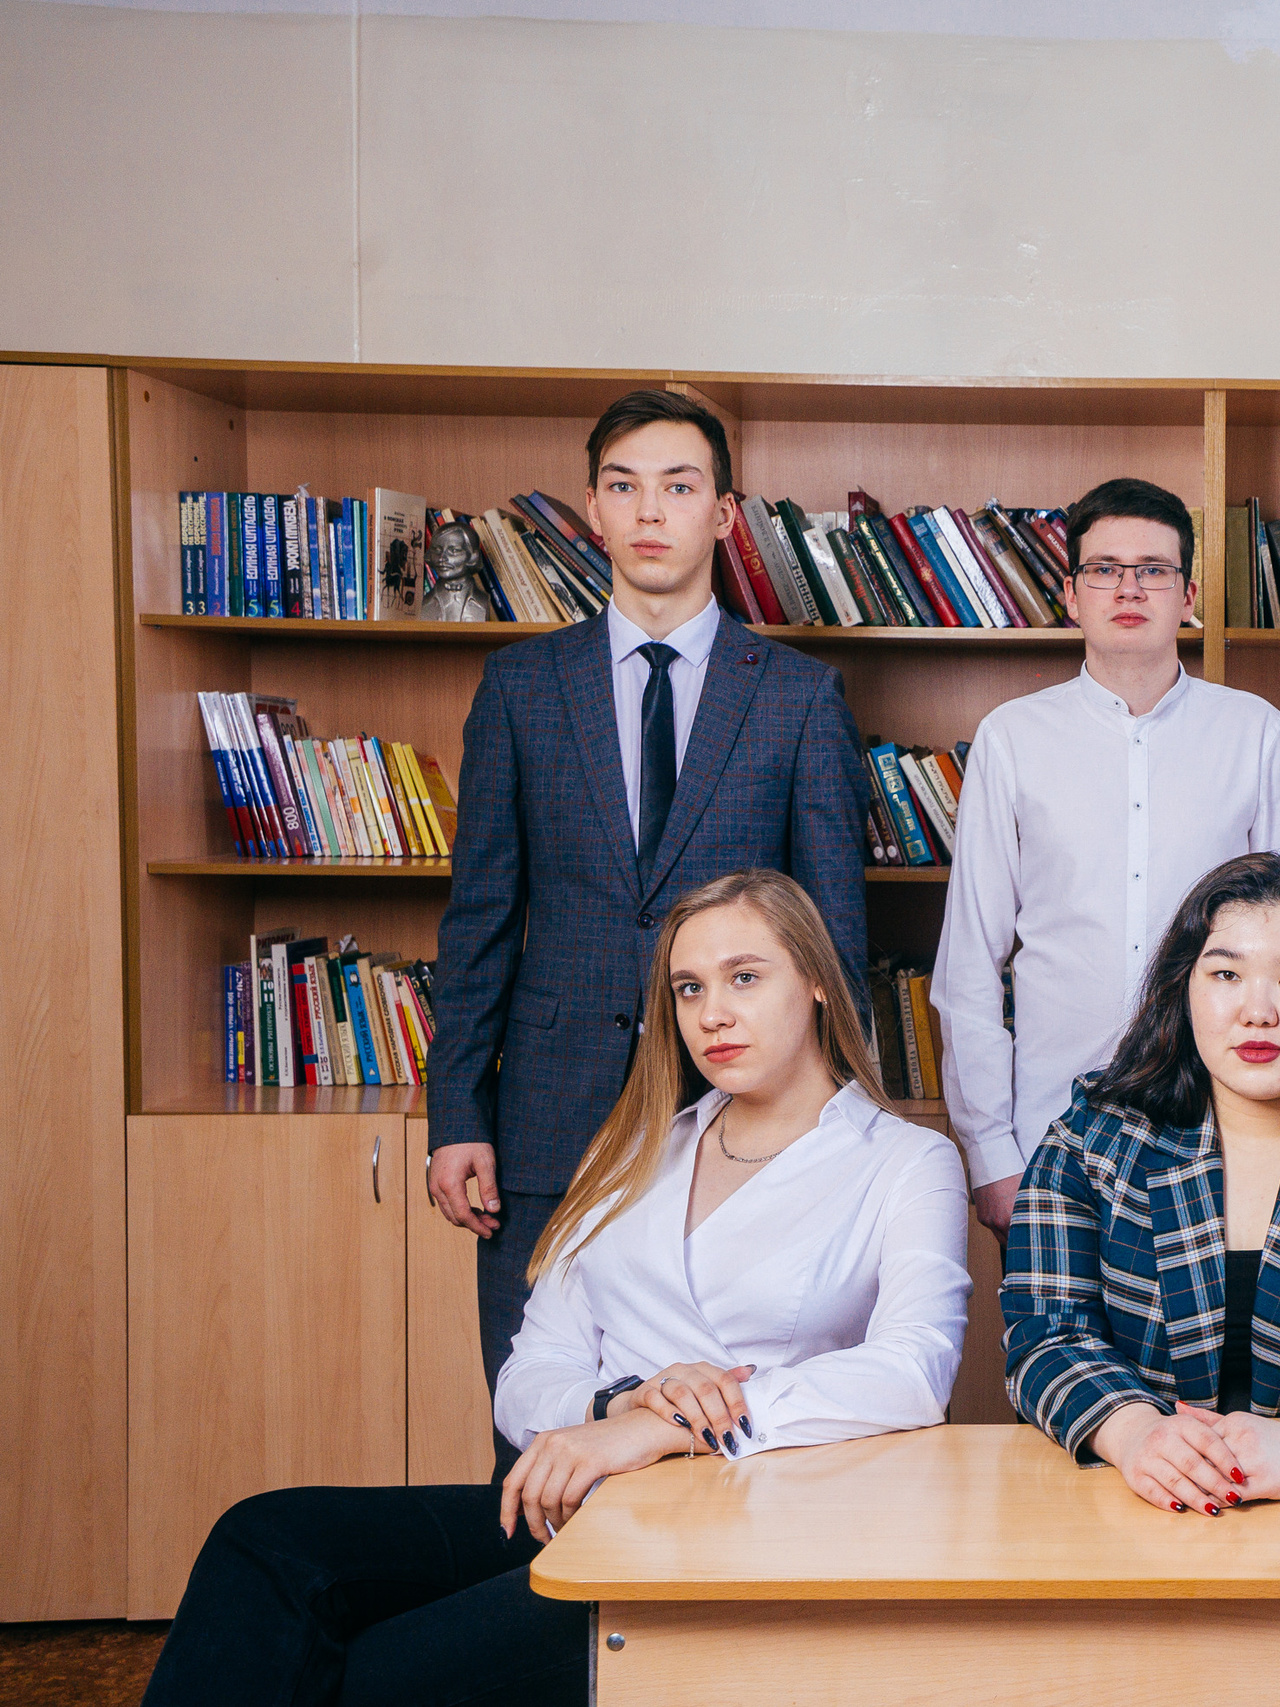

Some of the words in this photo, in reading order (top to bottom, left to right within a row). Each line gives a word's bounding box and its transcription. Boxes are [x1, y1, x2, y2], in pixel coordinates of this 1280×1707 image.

[243, 495, 257, 542] ЦИТАДЕЛЬ
[263, 495, 277, 543] ЦИТАДЕЛЬ
[283, 499, 298, 539] ЛИКБЕЗА
[244, 543, 258, 579] ЕДИНАЯ
[265, 544, 278, 580] ЕДИНАЯ
[285, 539, 300, 570] УРОКИ
[185, 600, 193, 614] 3
[198, 600, 205, 614] 3
[247, 598, 258, 617] 5
[269, 599, 279, 617] 5
[290, 600, 300, 616] 4
[281, 804, 300, 831] 800
[263, 981, 274, 991] 10
[263, 993, 274, 1003] 11
